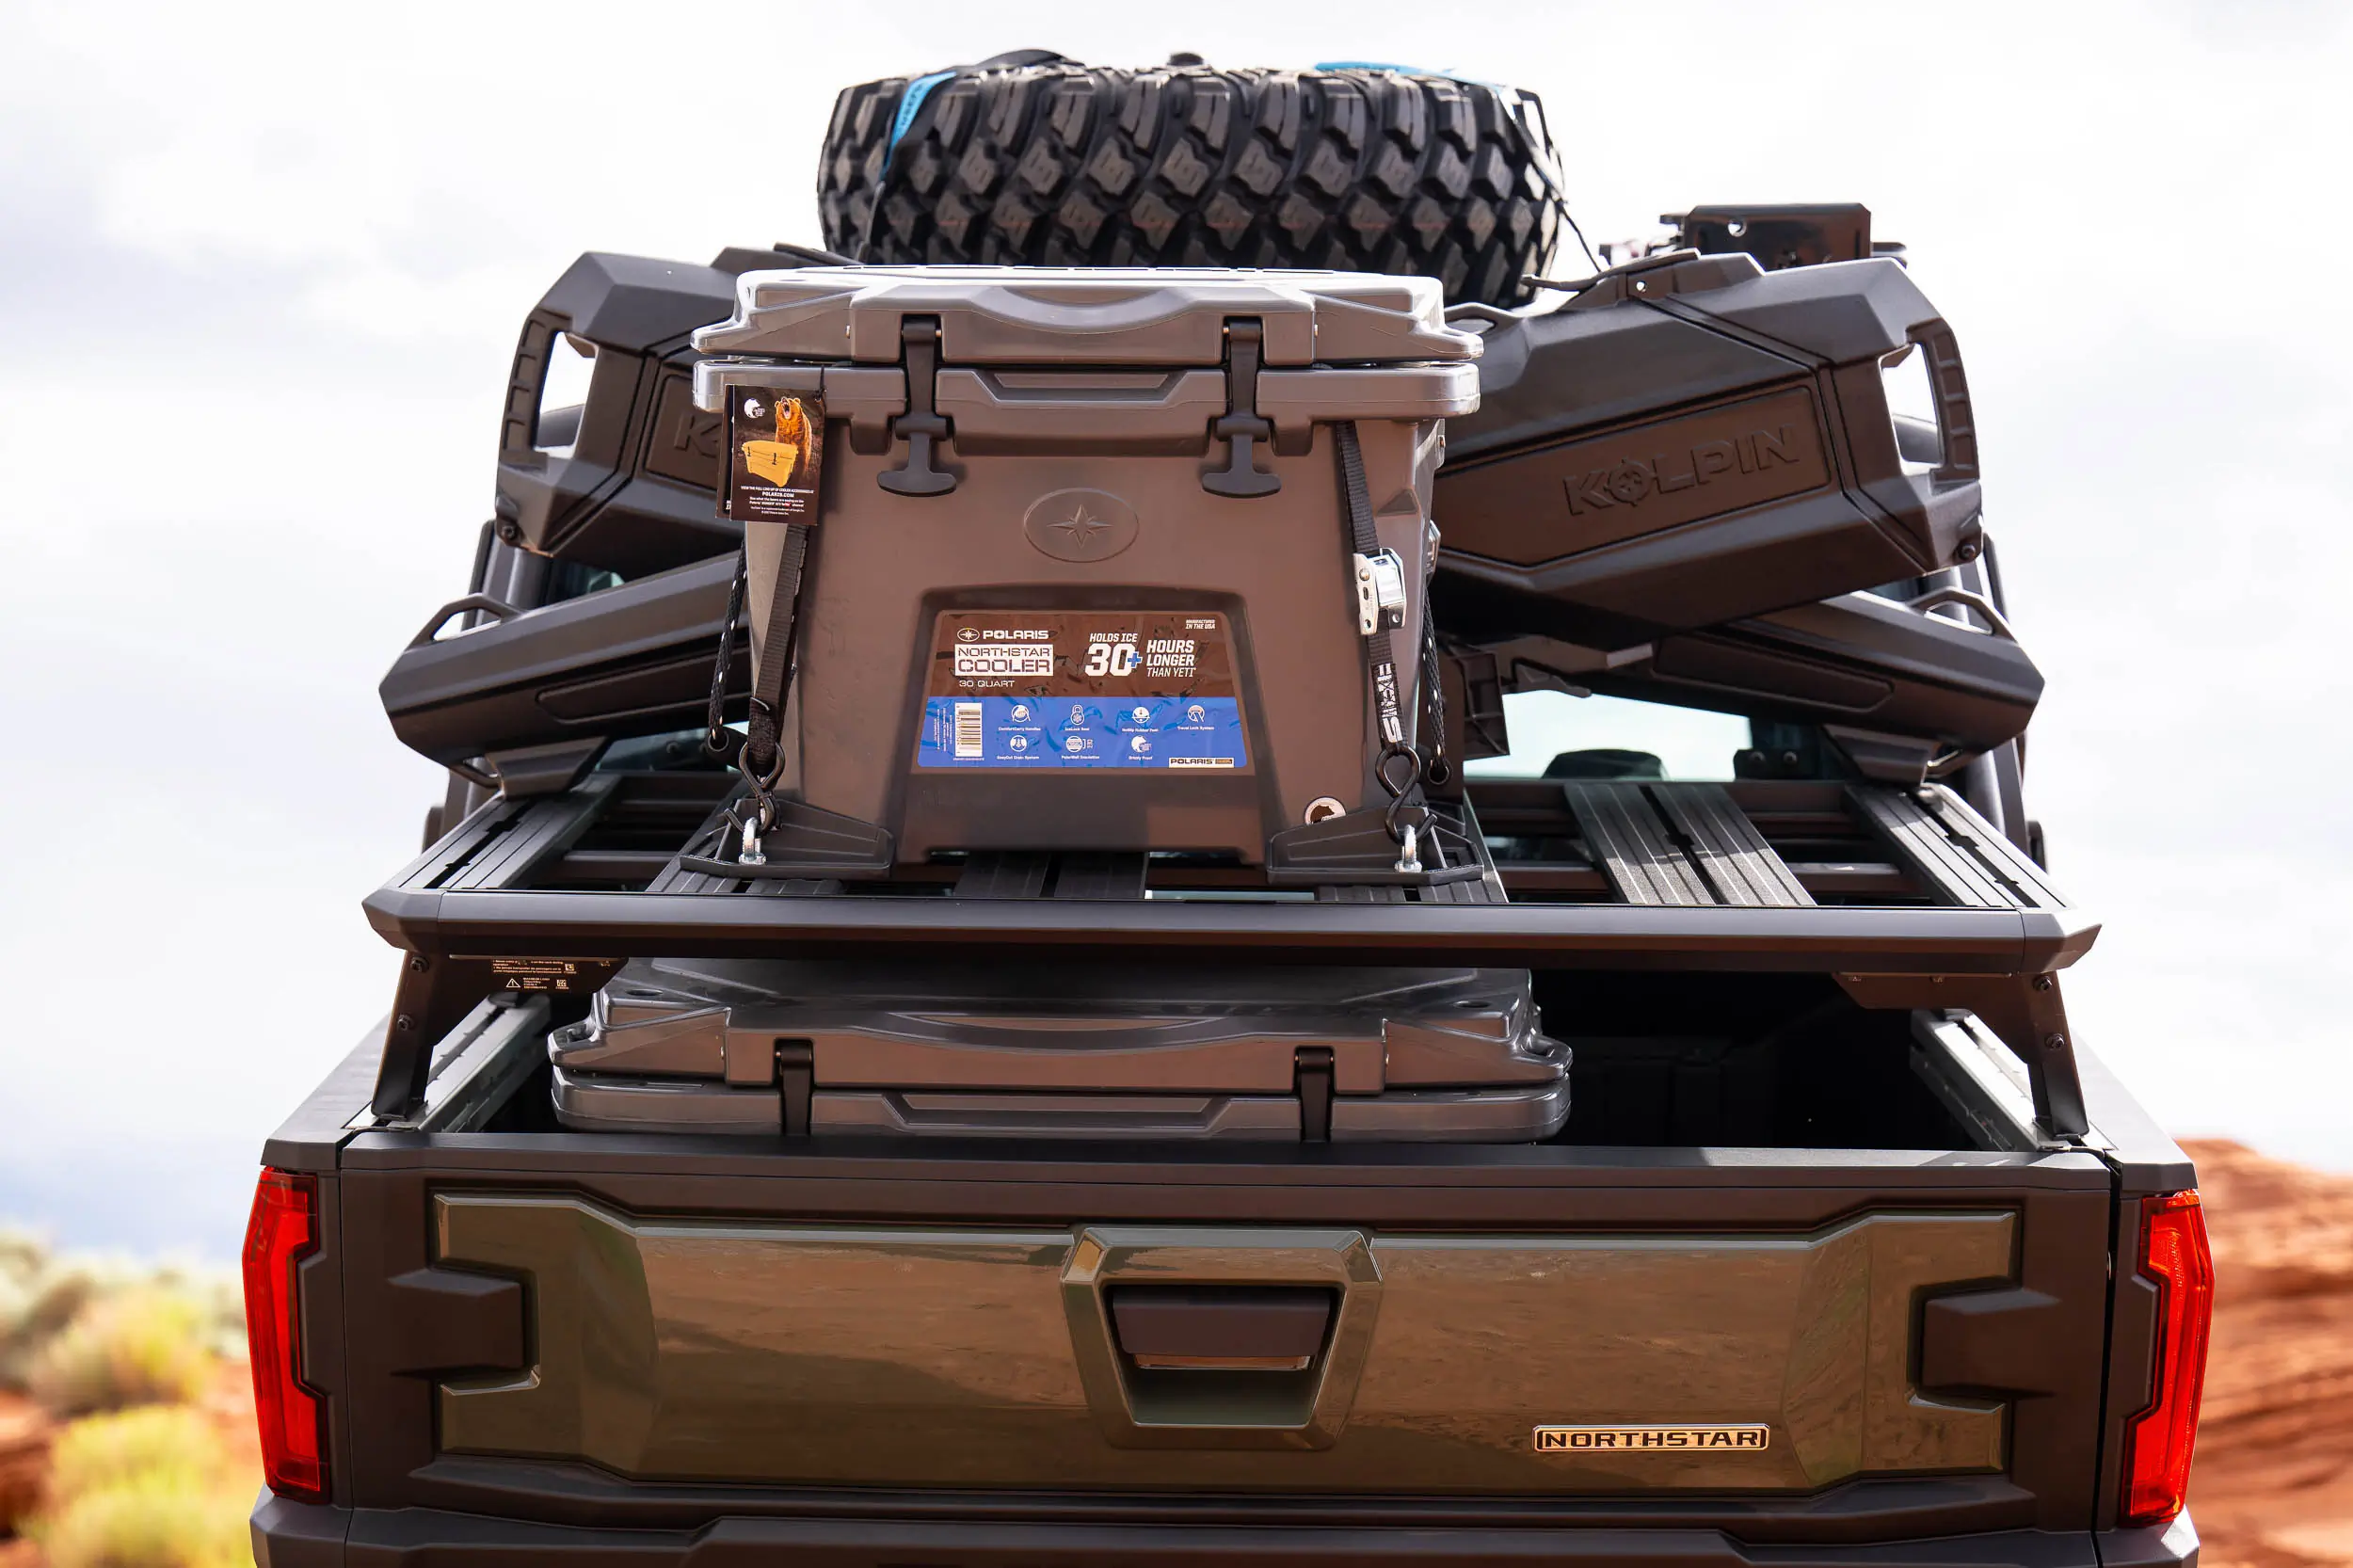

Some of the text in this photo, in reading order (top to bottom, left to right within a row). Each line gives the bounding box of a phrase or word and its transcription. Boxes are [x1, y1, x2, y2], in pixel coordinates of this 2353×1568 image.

[1561, 424, 1800, 516] KOLPIN
[983, 631, 1049, 639] POLARIS
[1090, 633, 1138, 642] HOLDS ICE
[958, 648, 1050, 656] NORTHSTAR
[1146, 640, 1194, 653] HOURS
[958, 660, 1050, 672] COOLER
[1146, 654, 1194, 666] LONGER
[1147, 667, 1195, 677] THAN YETI
[1545, 1432, 1758, 1448] NORTHSTAR
